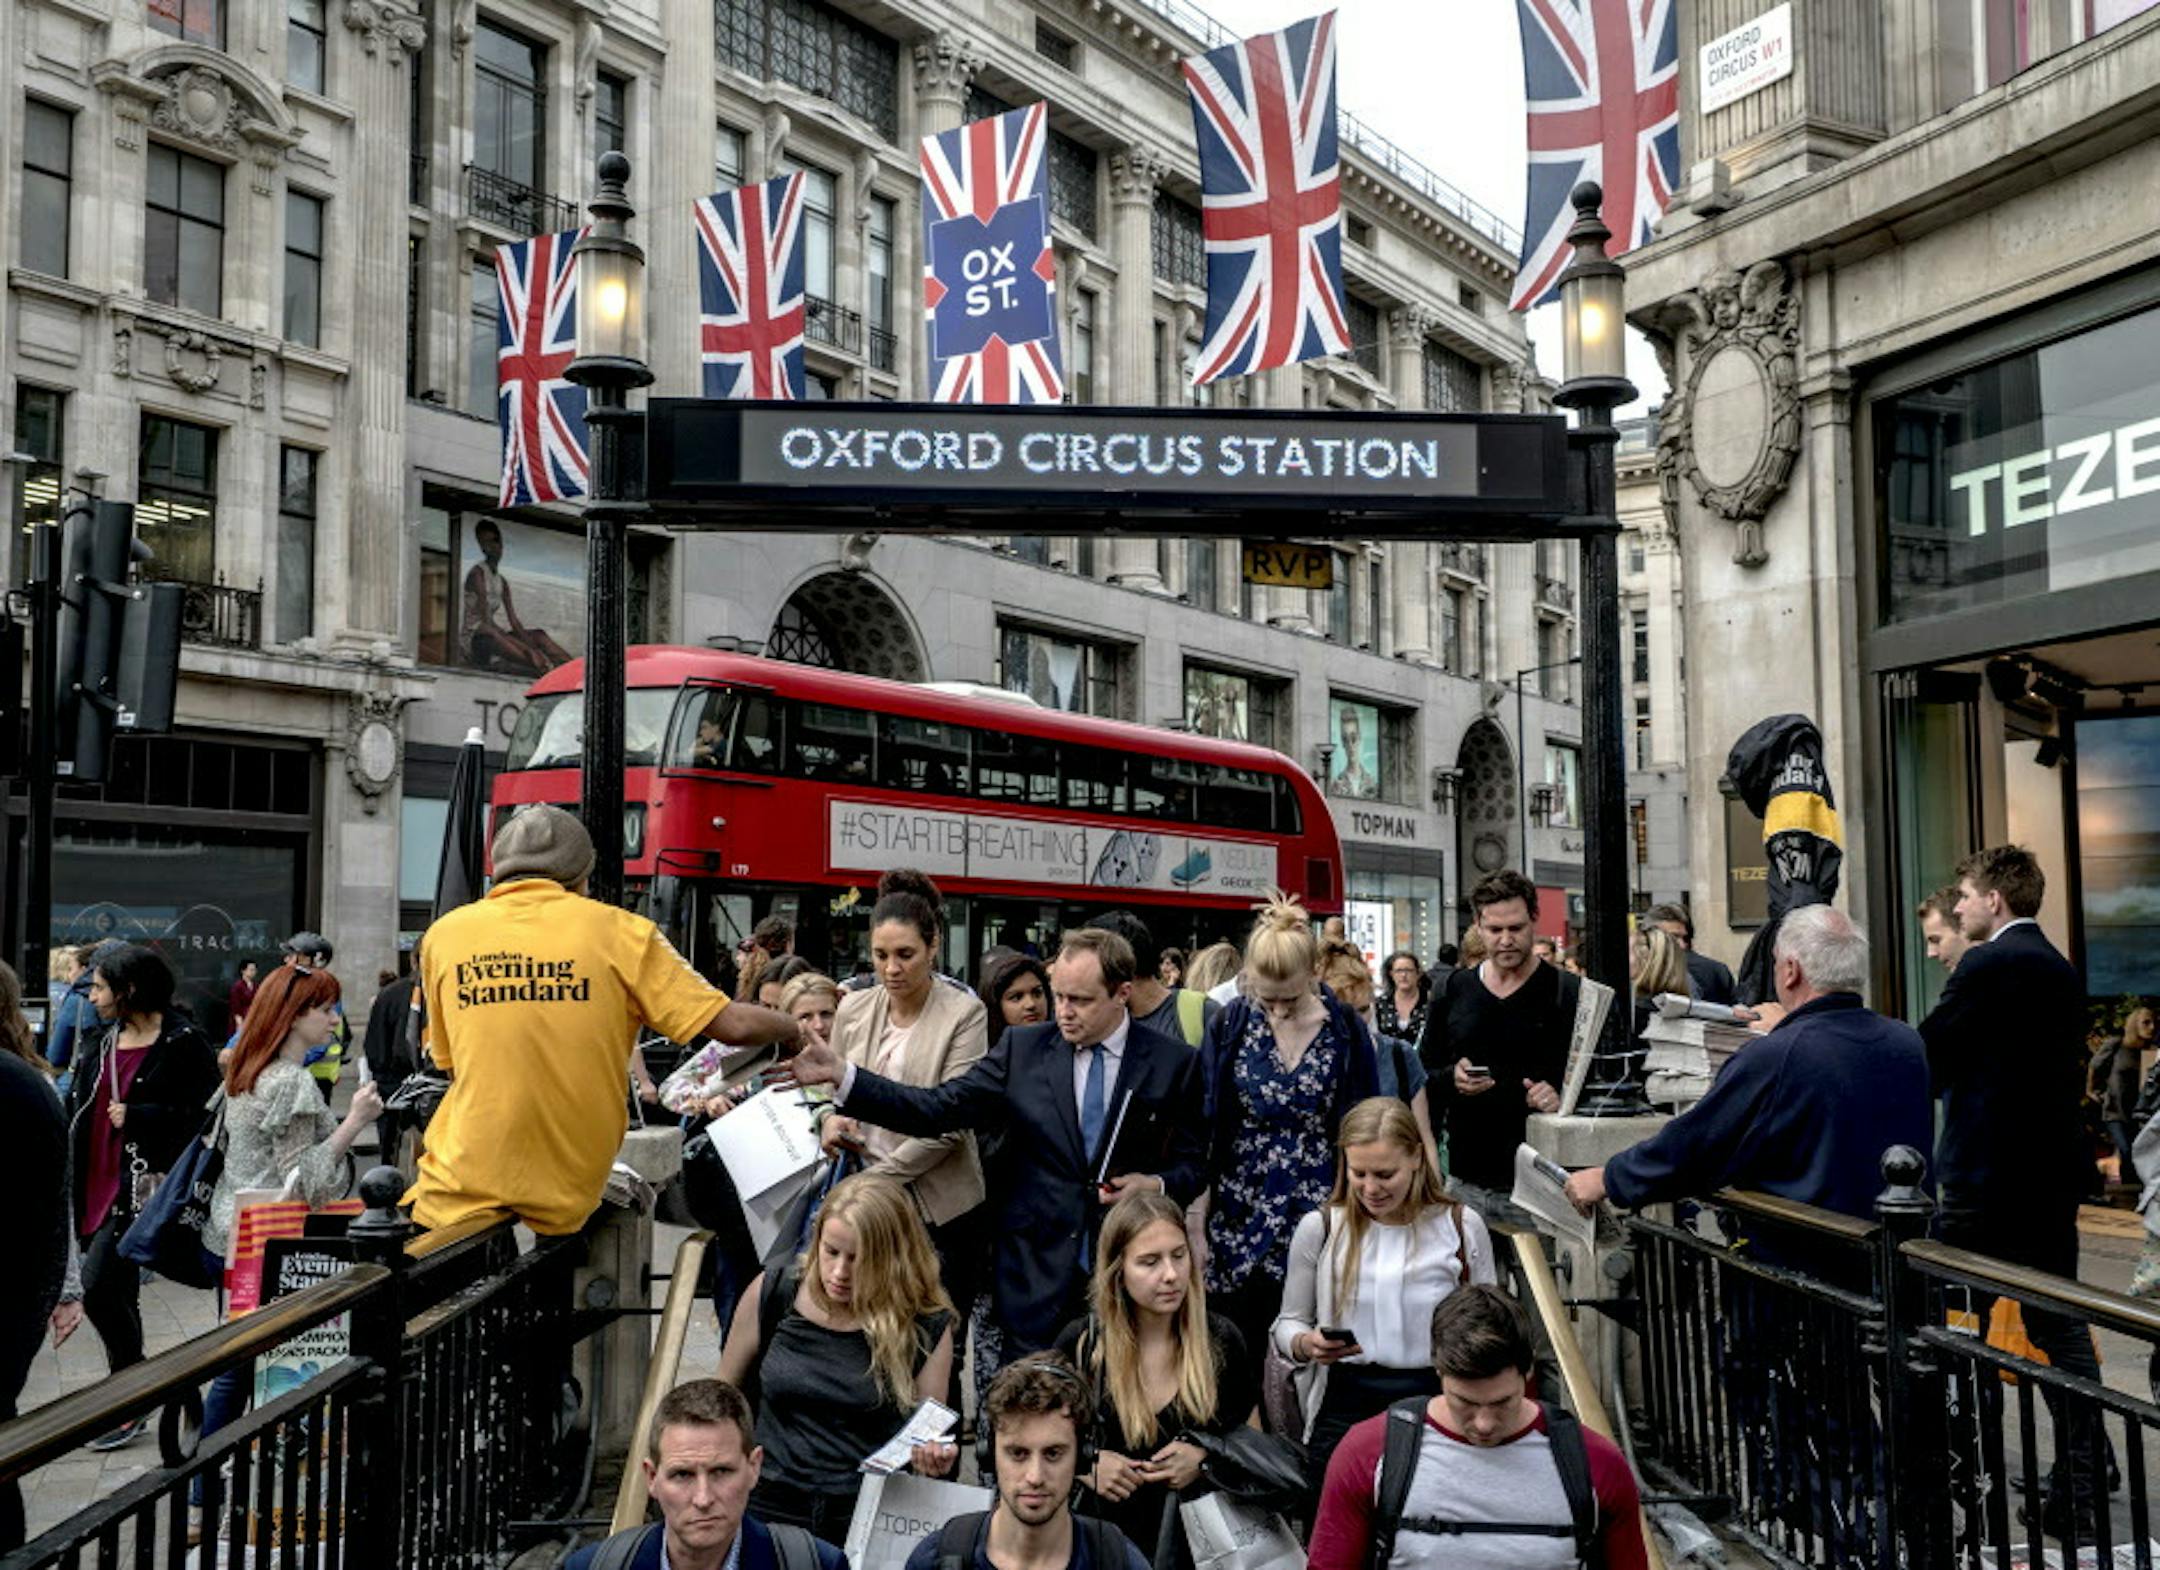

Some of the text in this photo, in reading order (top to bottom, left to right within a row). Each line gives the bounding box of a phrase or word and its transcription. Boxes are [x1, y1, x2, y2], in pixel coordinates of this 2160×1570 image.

[1708, 26, 1760, 66] OXFORD
[1708, 49, 1757, 87] CIRCUS
[1761, 36, 1783, 60] W1
[962, 241, 1015, 281] OX
[965, 277, 1018, 316] ST.
[781, 428, 1438, 479] OXFORD CIRCUS STATION
[1253, 549, 1324, 579] RVP
[1352, 811, 1416, 839] TOPMAN
[456, 957, 575, 986] Evening
[472, 951, 523, 964] London
[458, 978, 590, 1010] Standard
